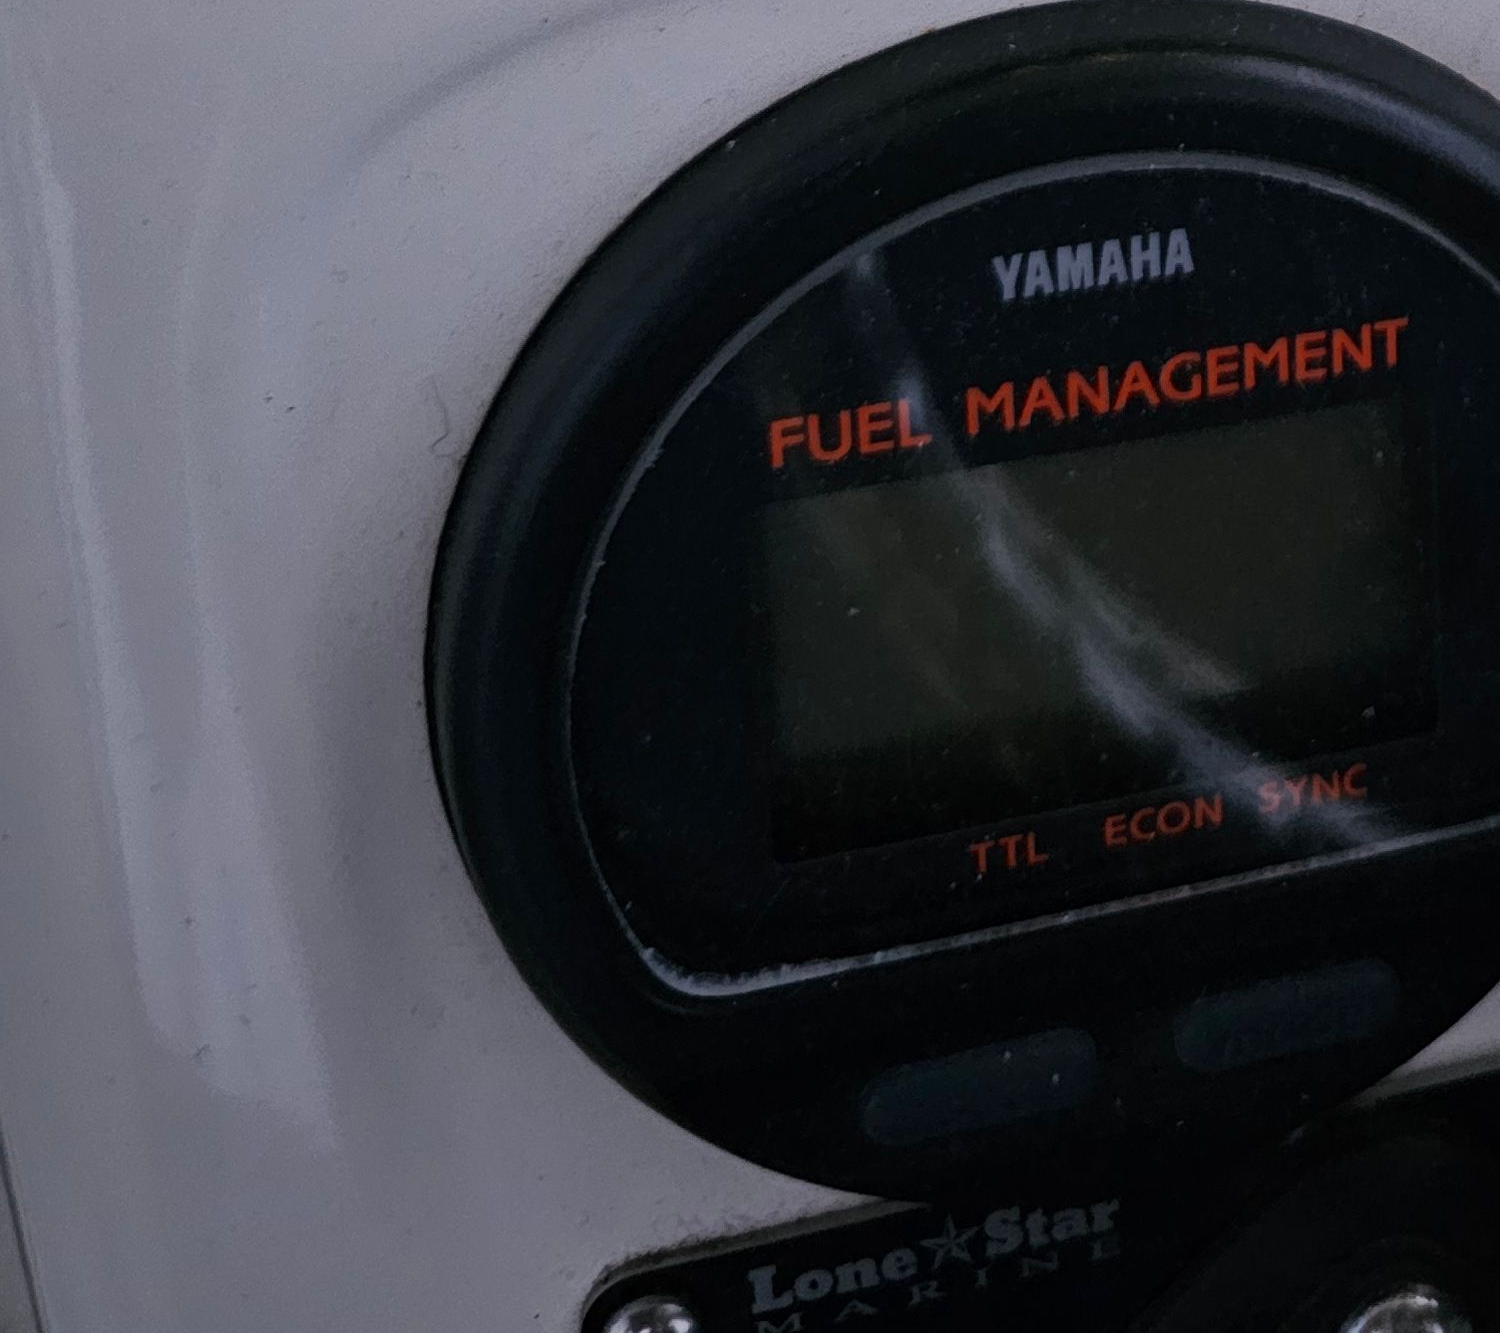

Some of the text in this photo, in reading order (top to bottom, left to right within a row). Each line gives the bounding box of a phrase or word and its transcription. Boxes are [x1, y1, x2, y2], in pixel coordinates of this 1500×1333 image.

[992, 228, 1195, 302] YAMAHA
[769, 317, 1410, 469] FUEL MANAGEMENT
[1103, 794, 1224, 847] ECON
[1258, 763, 1368, 816] SYNC
[969, 832, 1049, 873] TTL
[748, 1199, 1120, 1313] Lone Star
